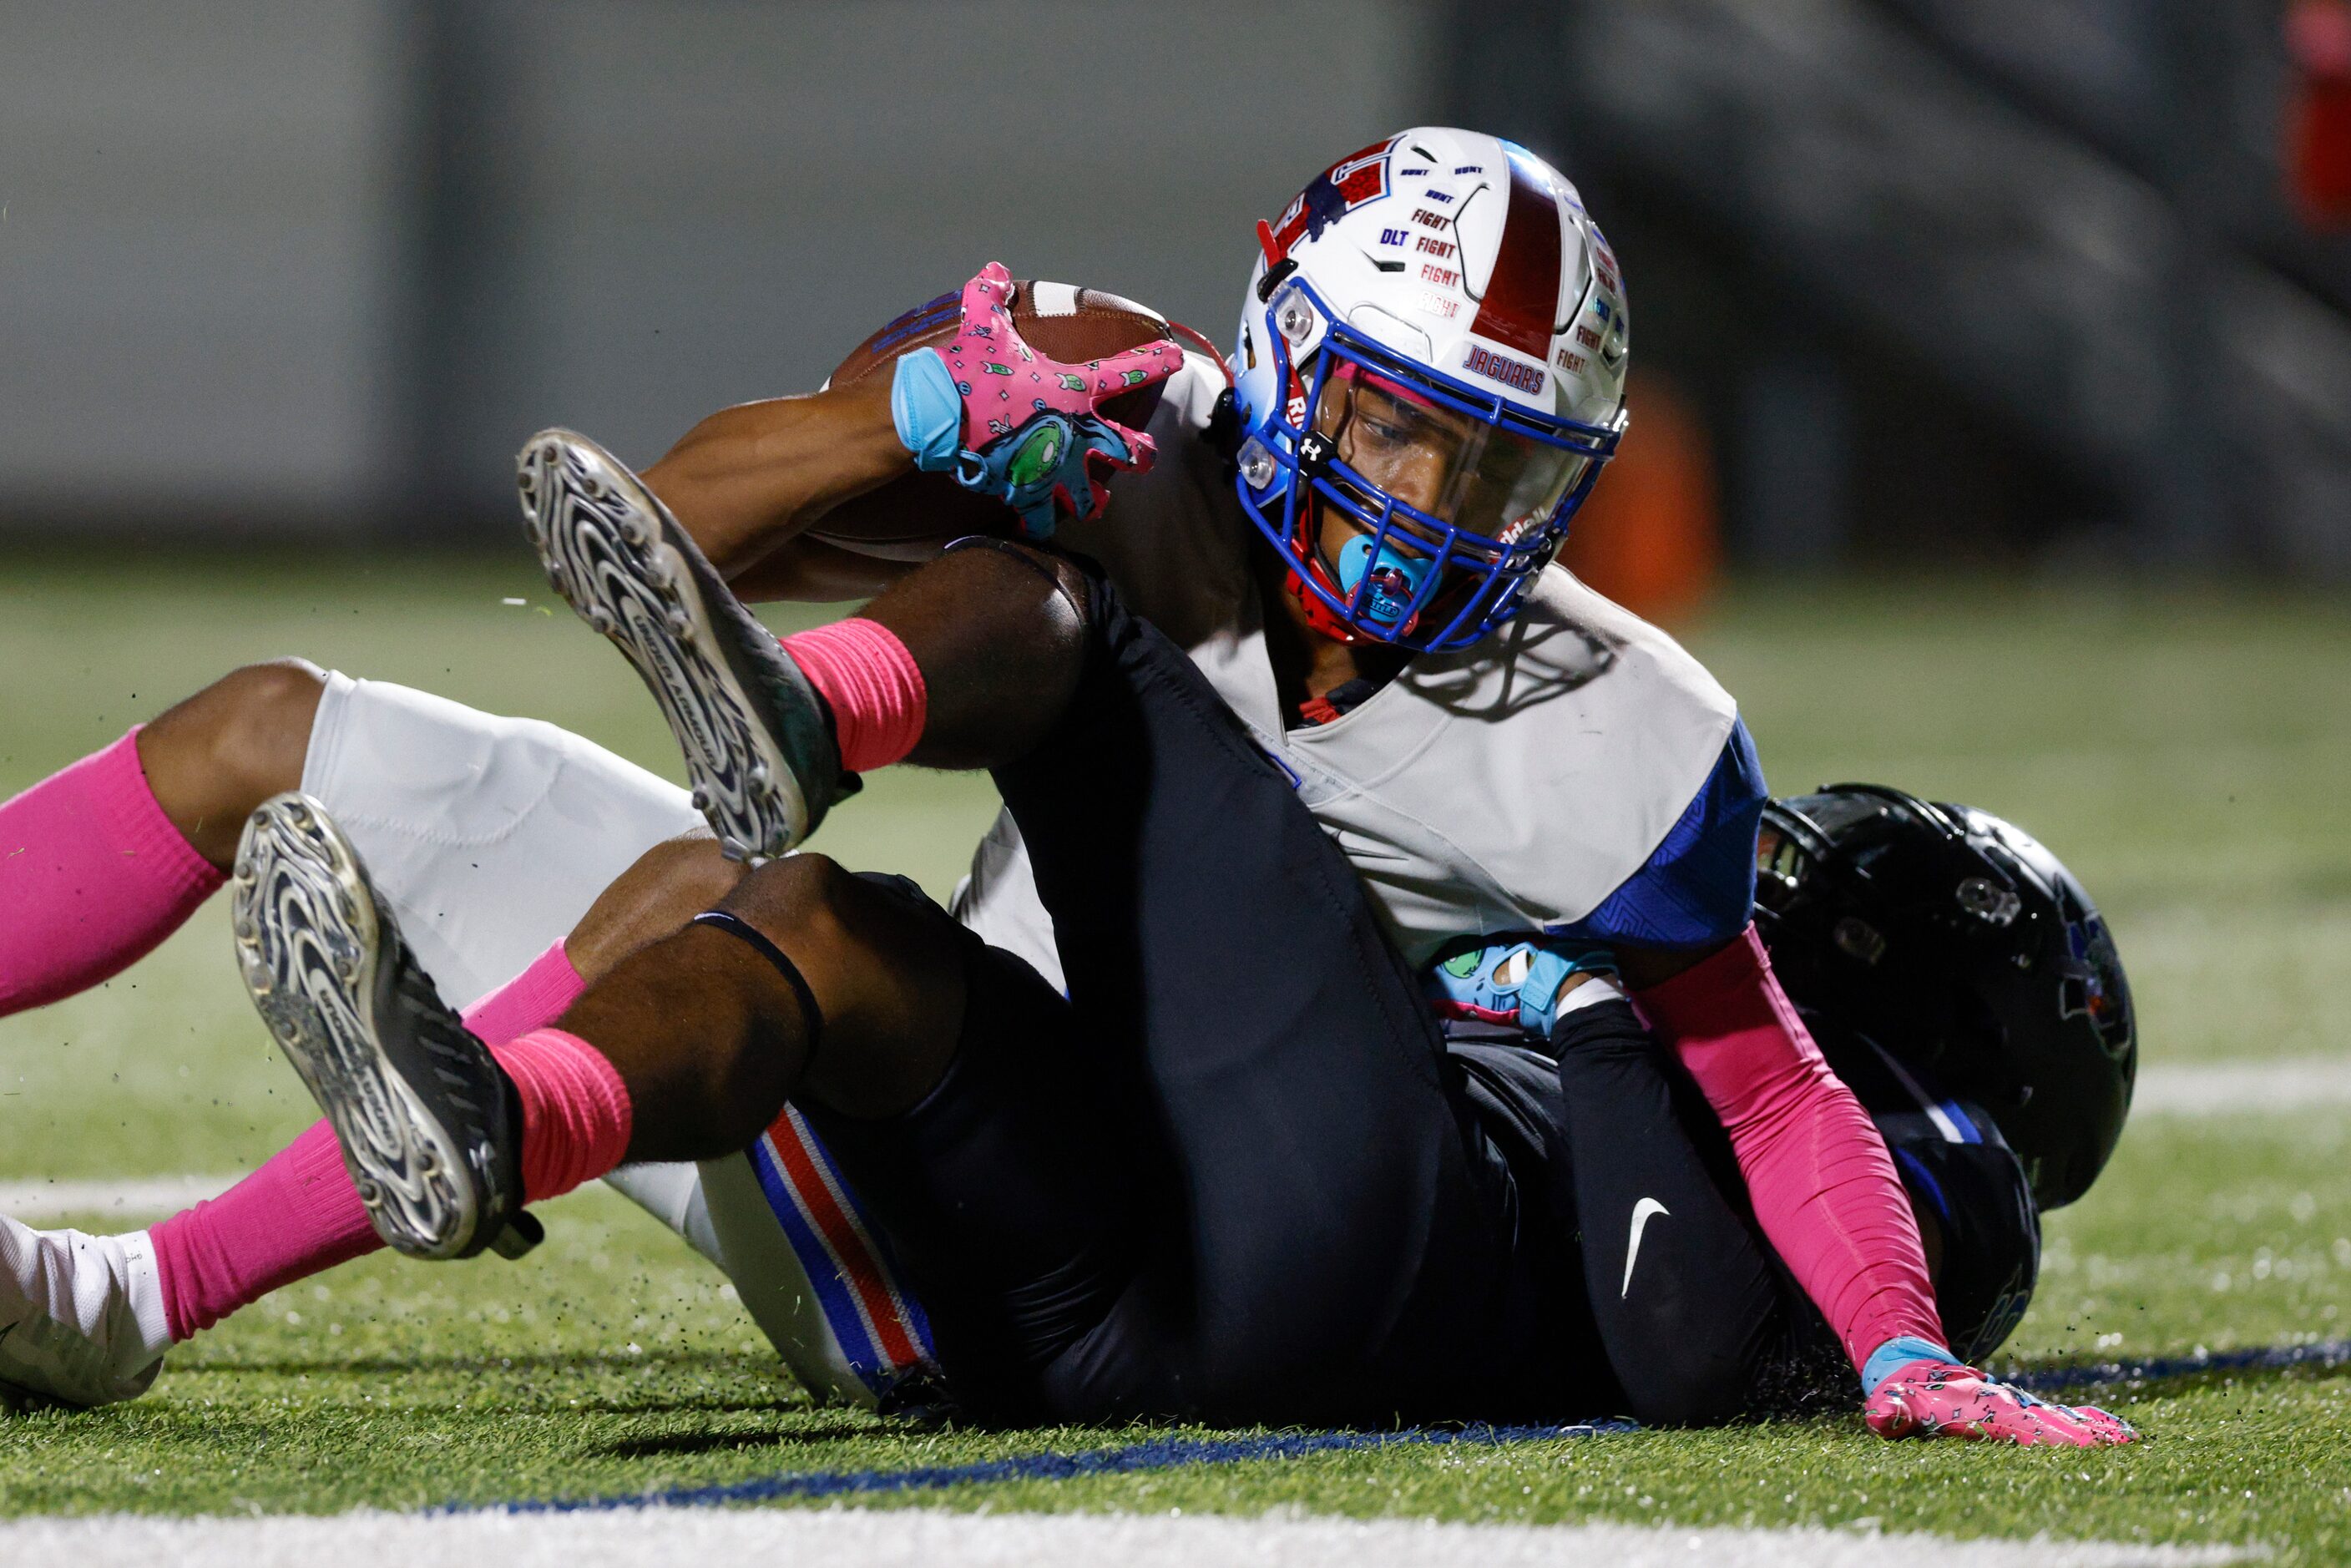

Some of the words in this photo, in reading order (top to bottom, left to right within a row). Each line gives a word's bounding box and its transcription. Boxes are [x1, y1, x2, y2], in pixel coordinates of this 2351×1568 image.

[1424, 189, 1454, 204] HUNT
[1411, 208, 1451, 231] FIGHT
[1380, 228, 1409, 246] DLT
[1416, 236, 1456, 259] FIGHT
[1421, 264, 1461, 287] FIGHT
[1463, 344, 1545, 396] JAGUARS
[1556, 349, 1585, 374] FIGHT
[1499, 506, 1546, 545] ddell
[633, 615, 674, 679] UNDER
